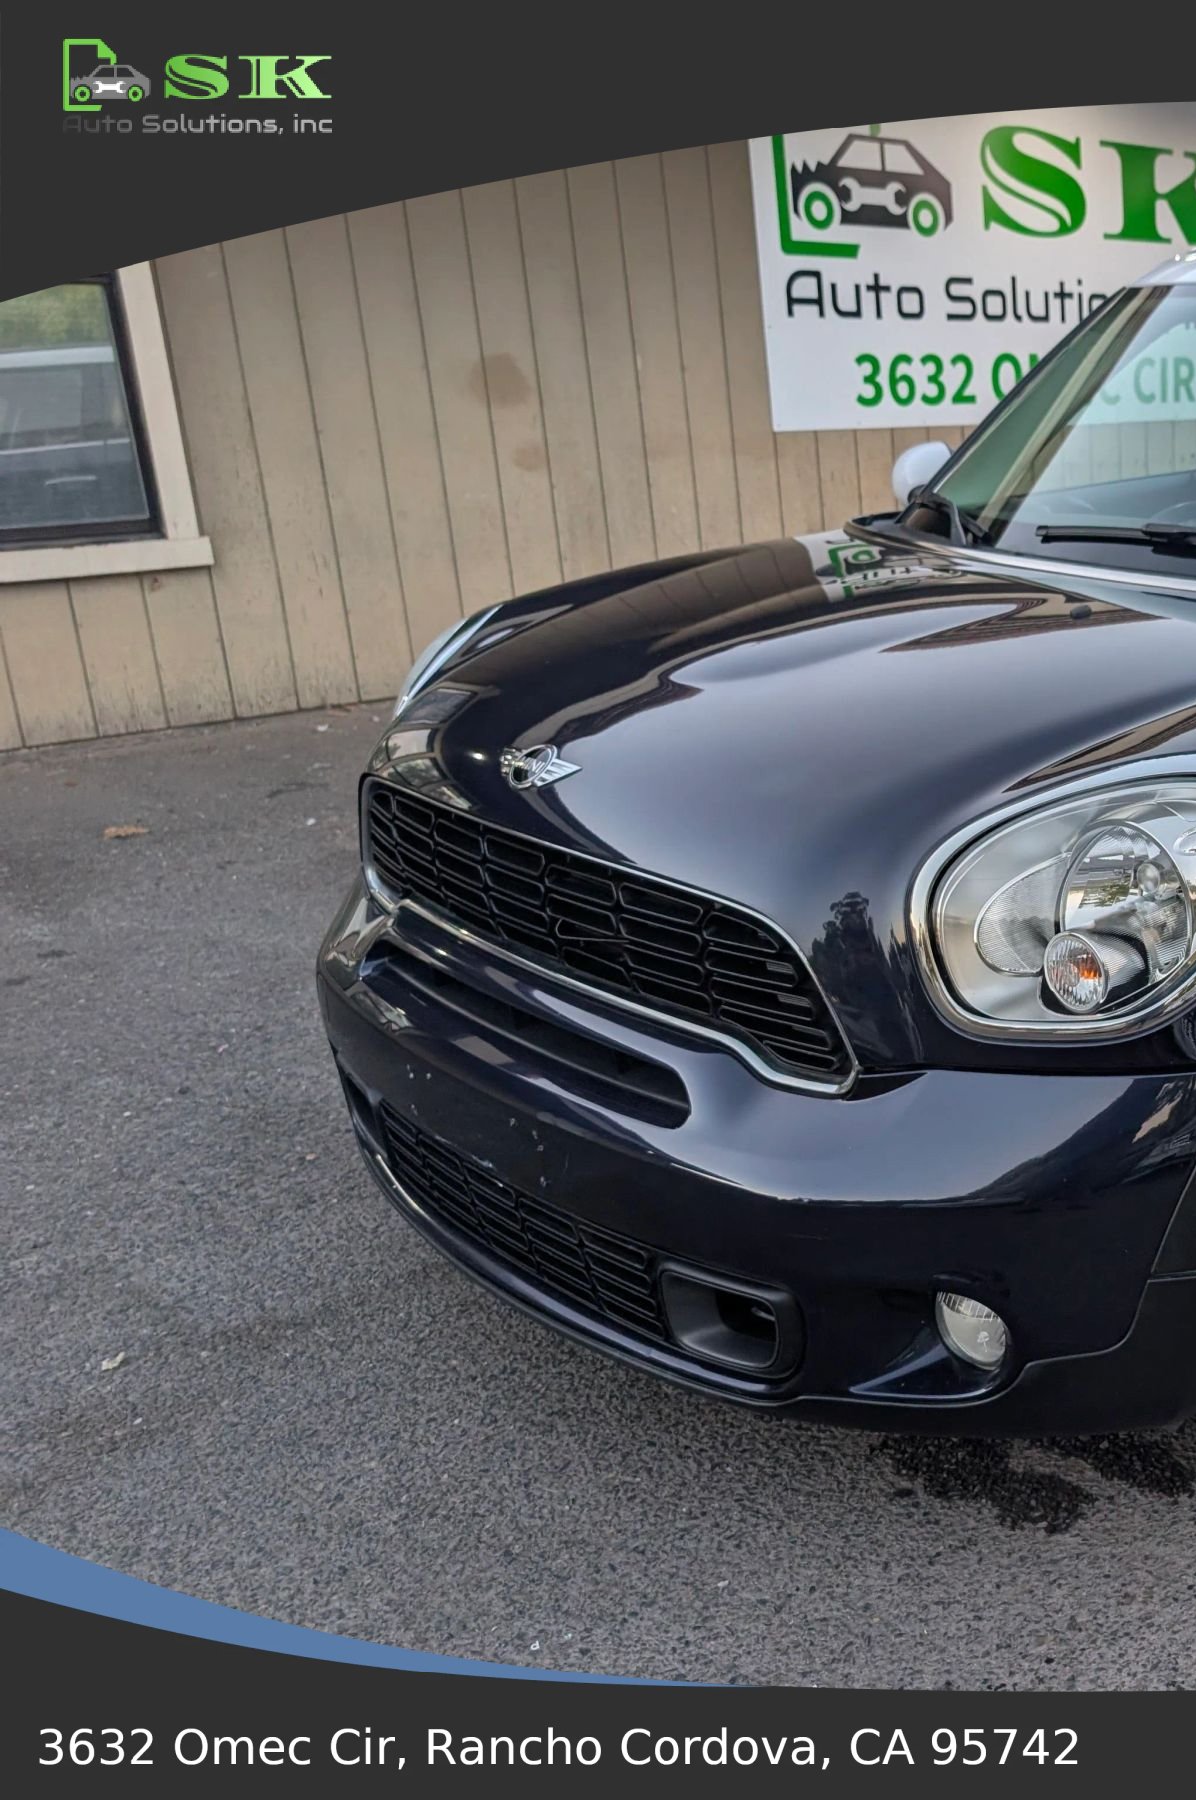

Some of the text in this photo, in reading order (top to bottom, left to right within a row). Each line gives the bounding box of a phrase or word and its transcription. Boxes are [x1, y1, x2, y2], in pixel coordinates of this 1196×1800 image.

[786, 270, 925, 319] Auto
[855, 353, 977, 407] 3632
[1133, 356, 1196, 404] CIR
